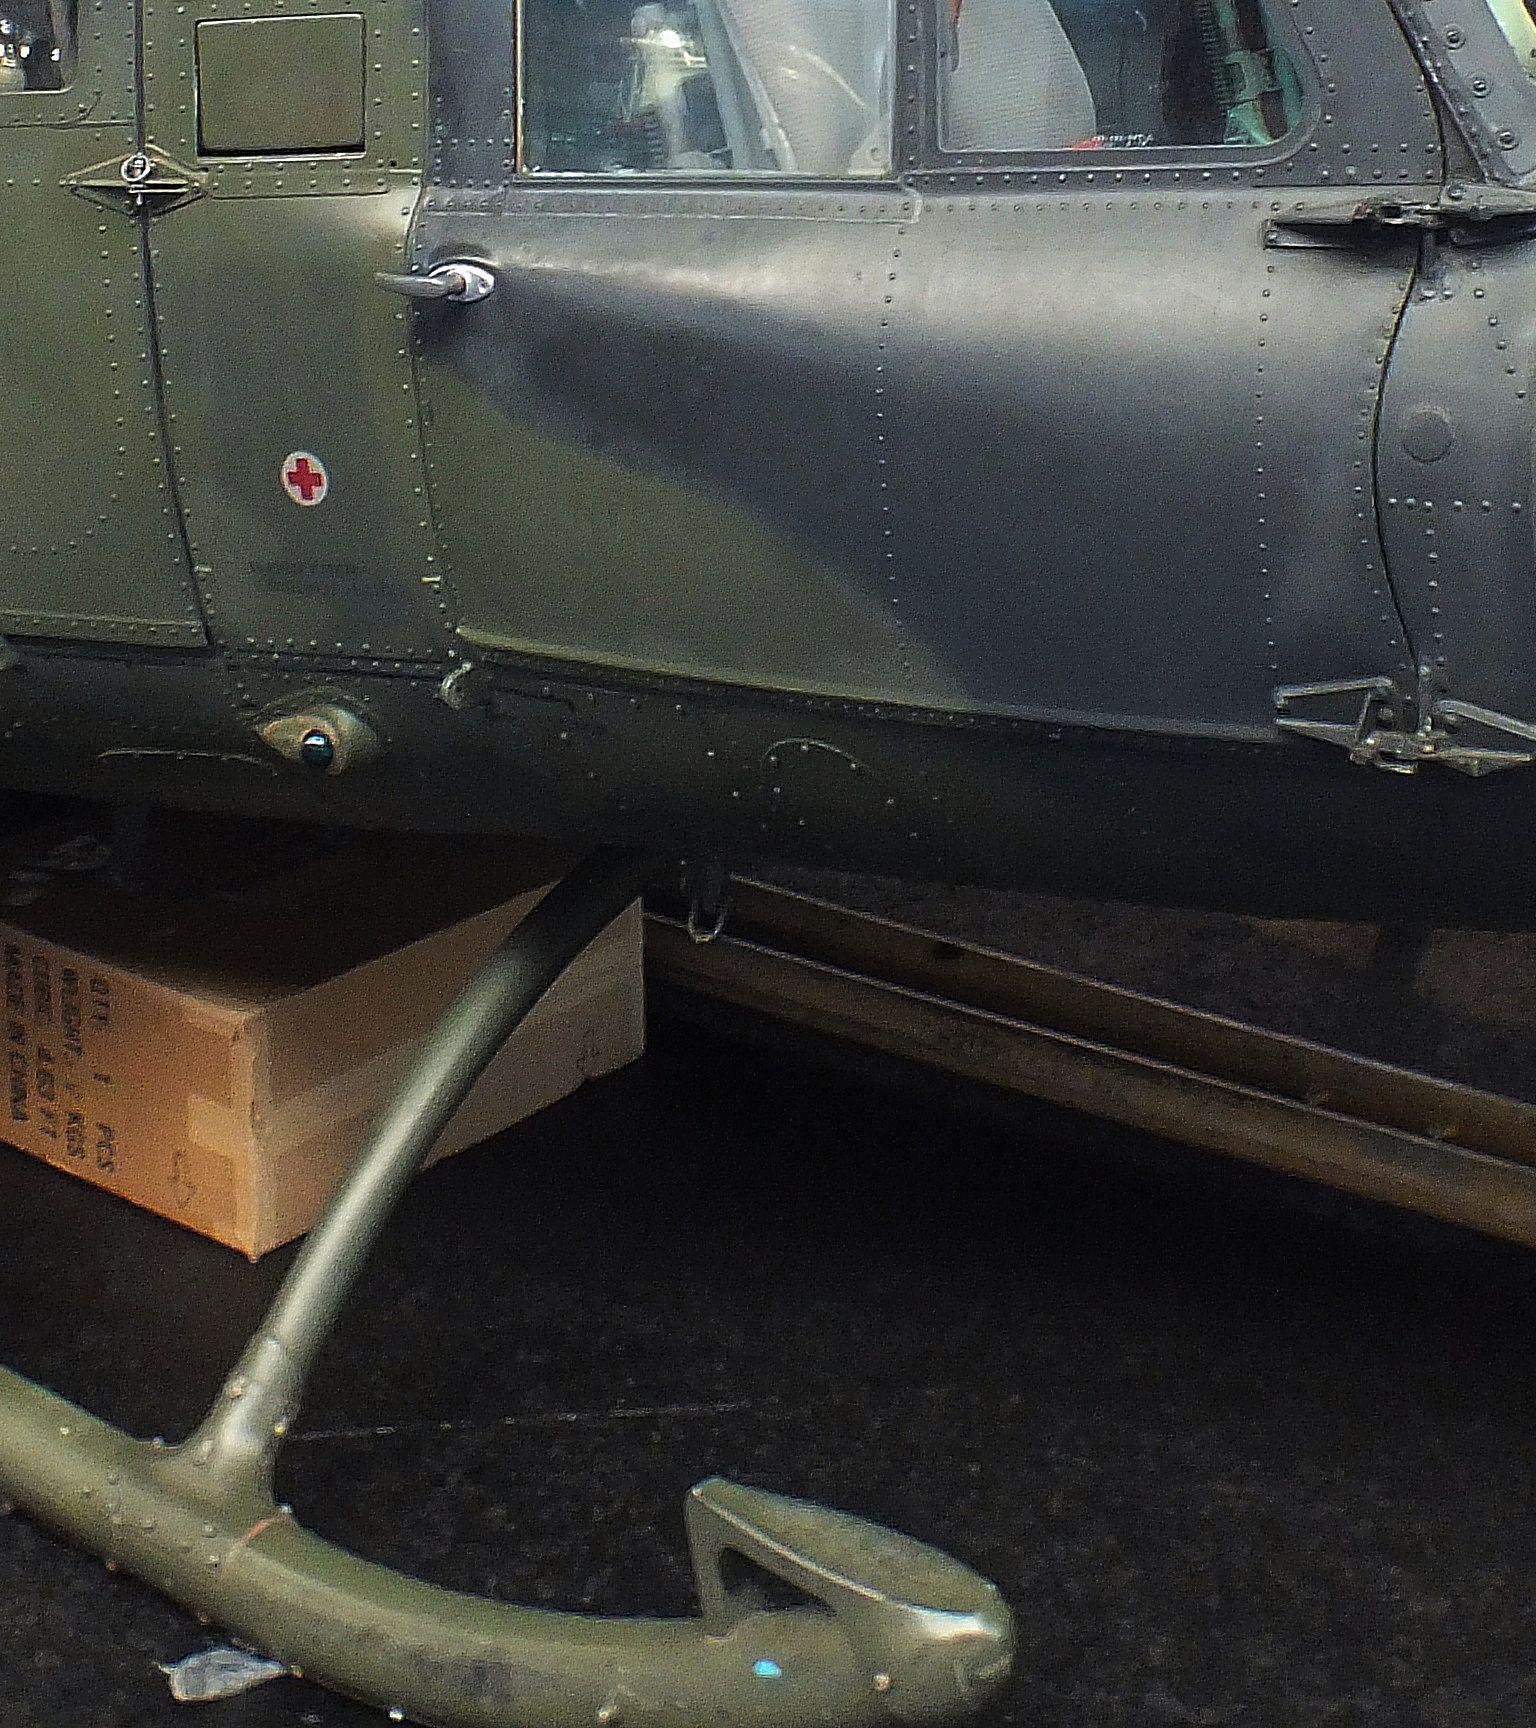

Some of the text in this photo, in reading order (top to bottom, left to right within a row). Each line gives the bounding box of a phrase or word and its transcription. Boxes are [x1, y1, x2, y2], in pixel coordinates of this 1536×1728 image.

[4, 942, 30, 1121] MADE IN CHINA
[65, 1110, 86, 1159] KGS
[96, 1122, 116, 1172] PCS
